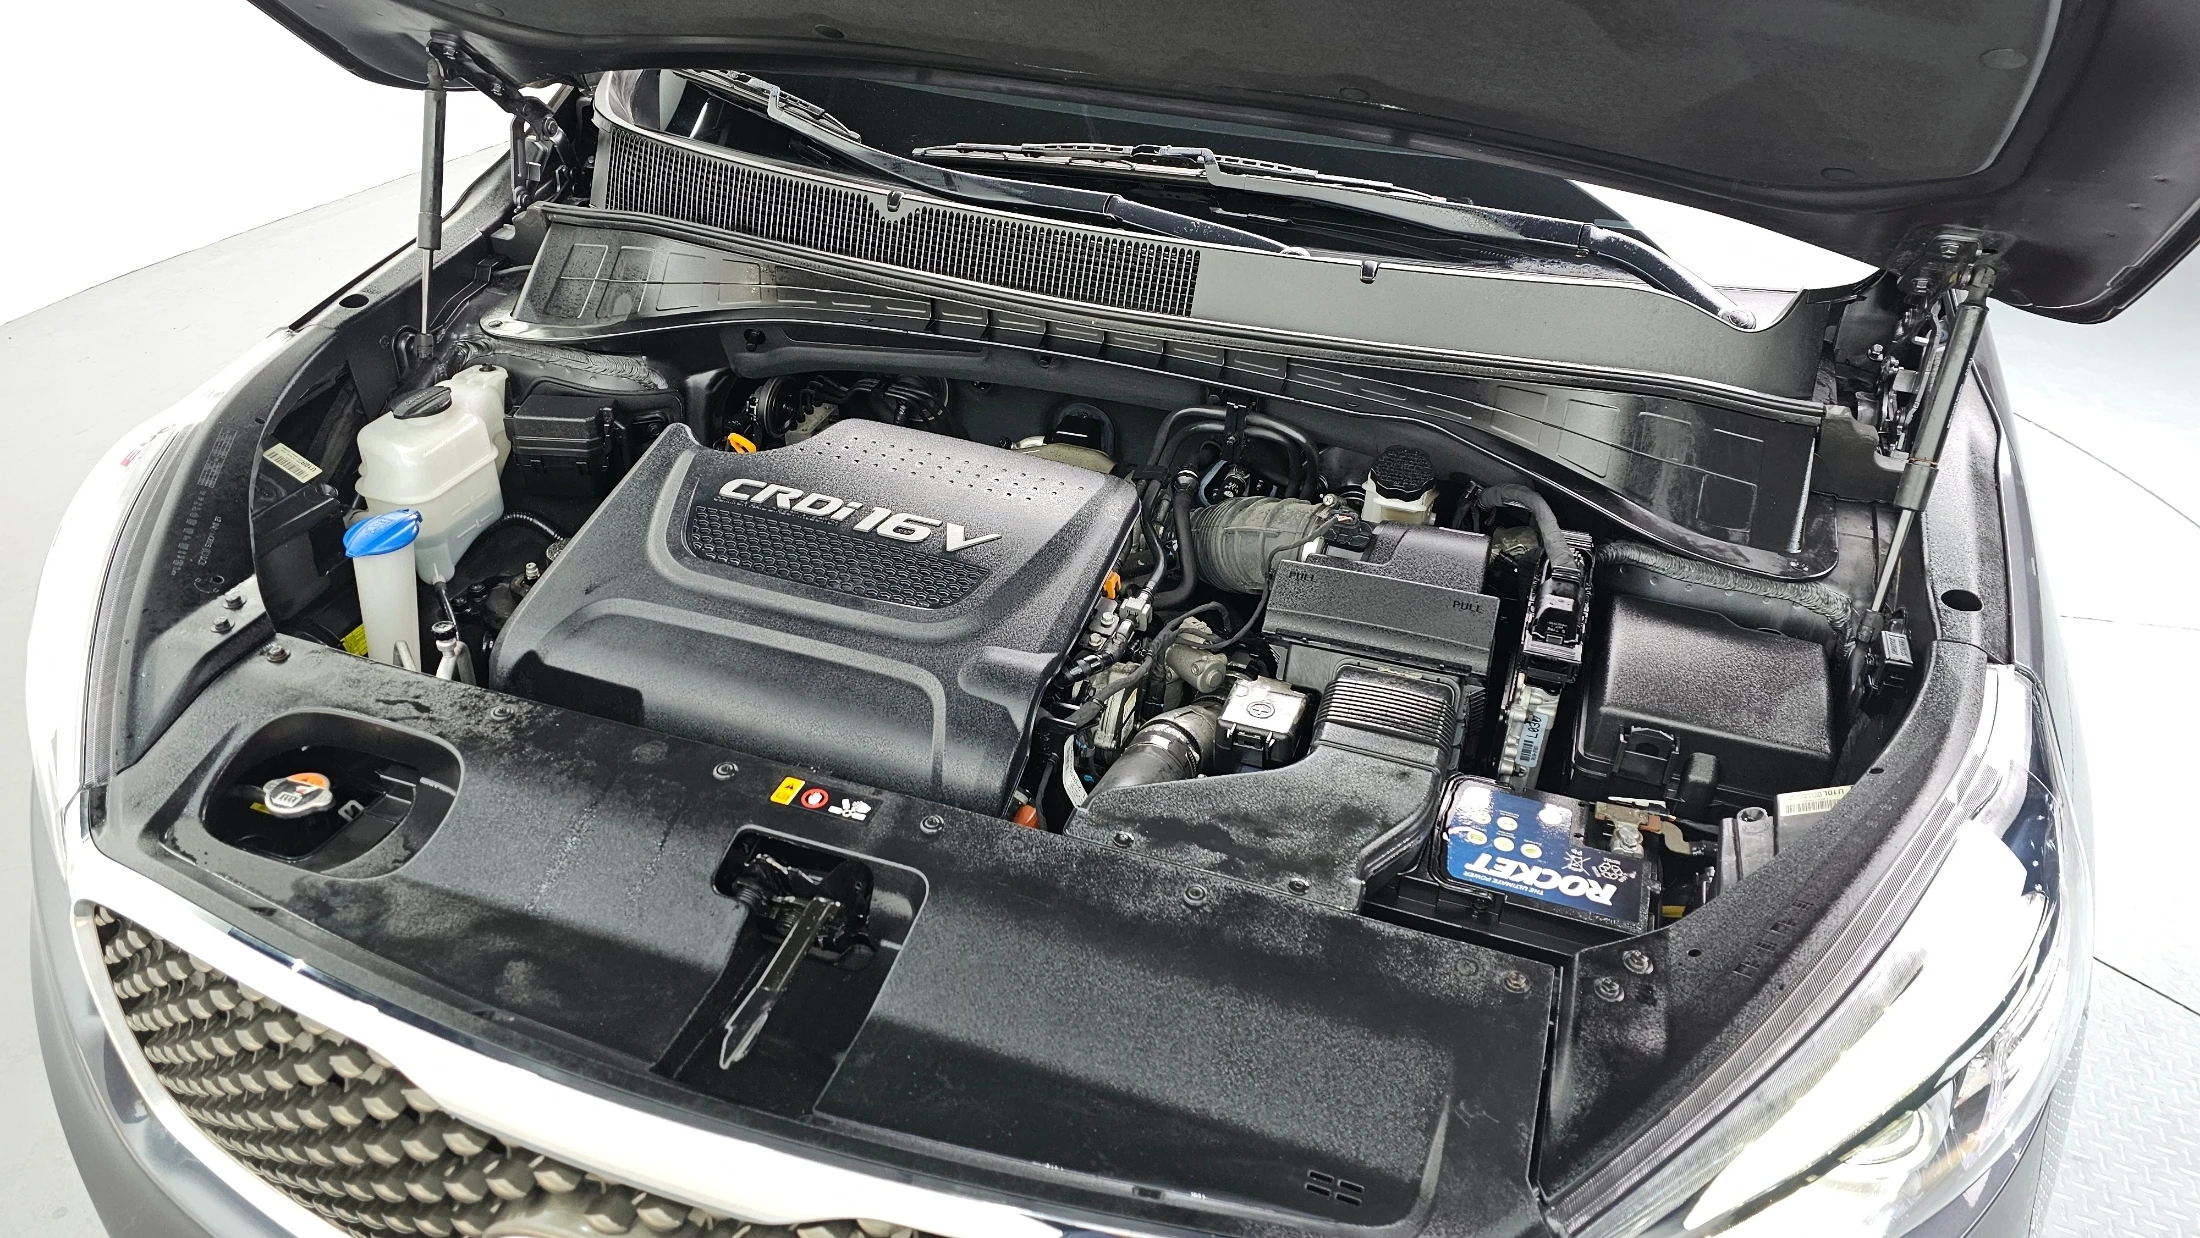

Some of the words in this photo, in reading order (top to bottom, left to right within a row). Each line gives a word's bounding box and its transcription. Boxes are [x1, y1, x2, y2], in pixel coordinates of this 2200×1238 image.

[719, 478, 863, 522] CRDi
[1289, 570, 1316, 582] PULL
[1452, 600, 1483, 614] PULL
[1463, 871, 1491, 884] POWER
[1464, 852, 1618, 907] ROCKET
[1492, 878, 1530, 893] ULTIMATE
[1532, 887, 1545, 897] THE
